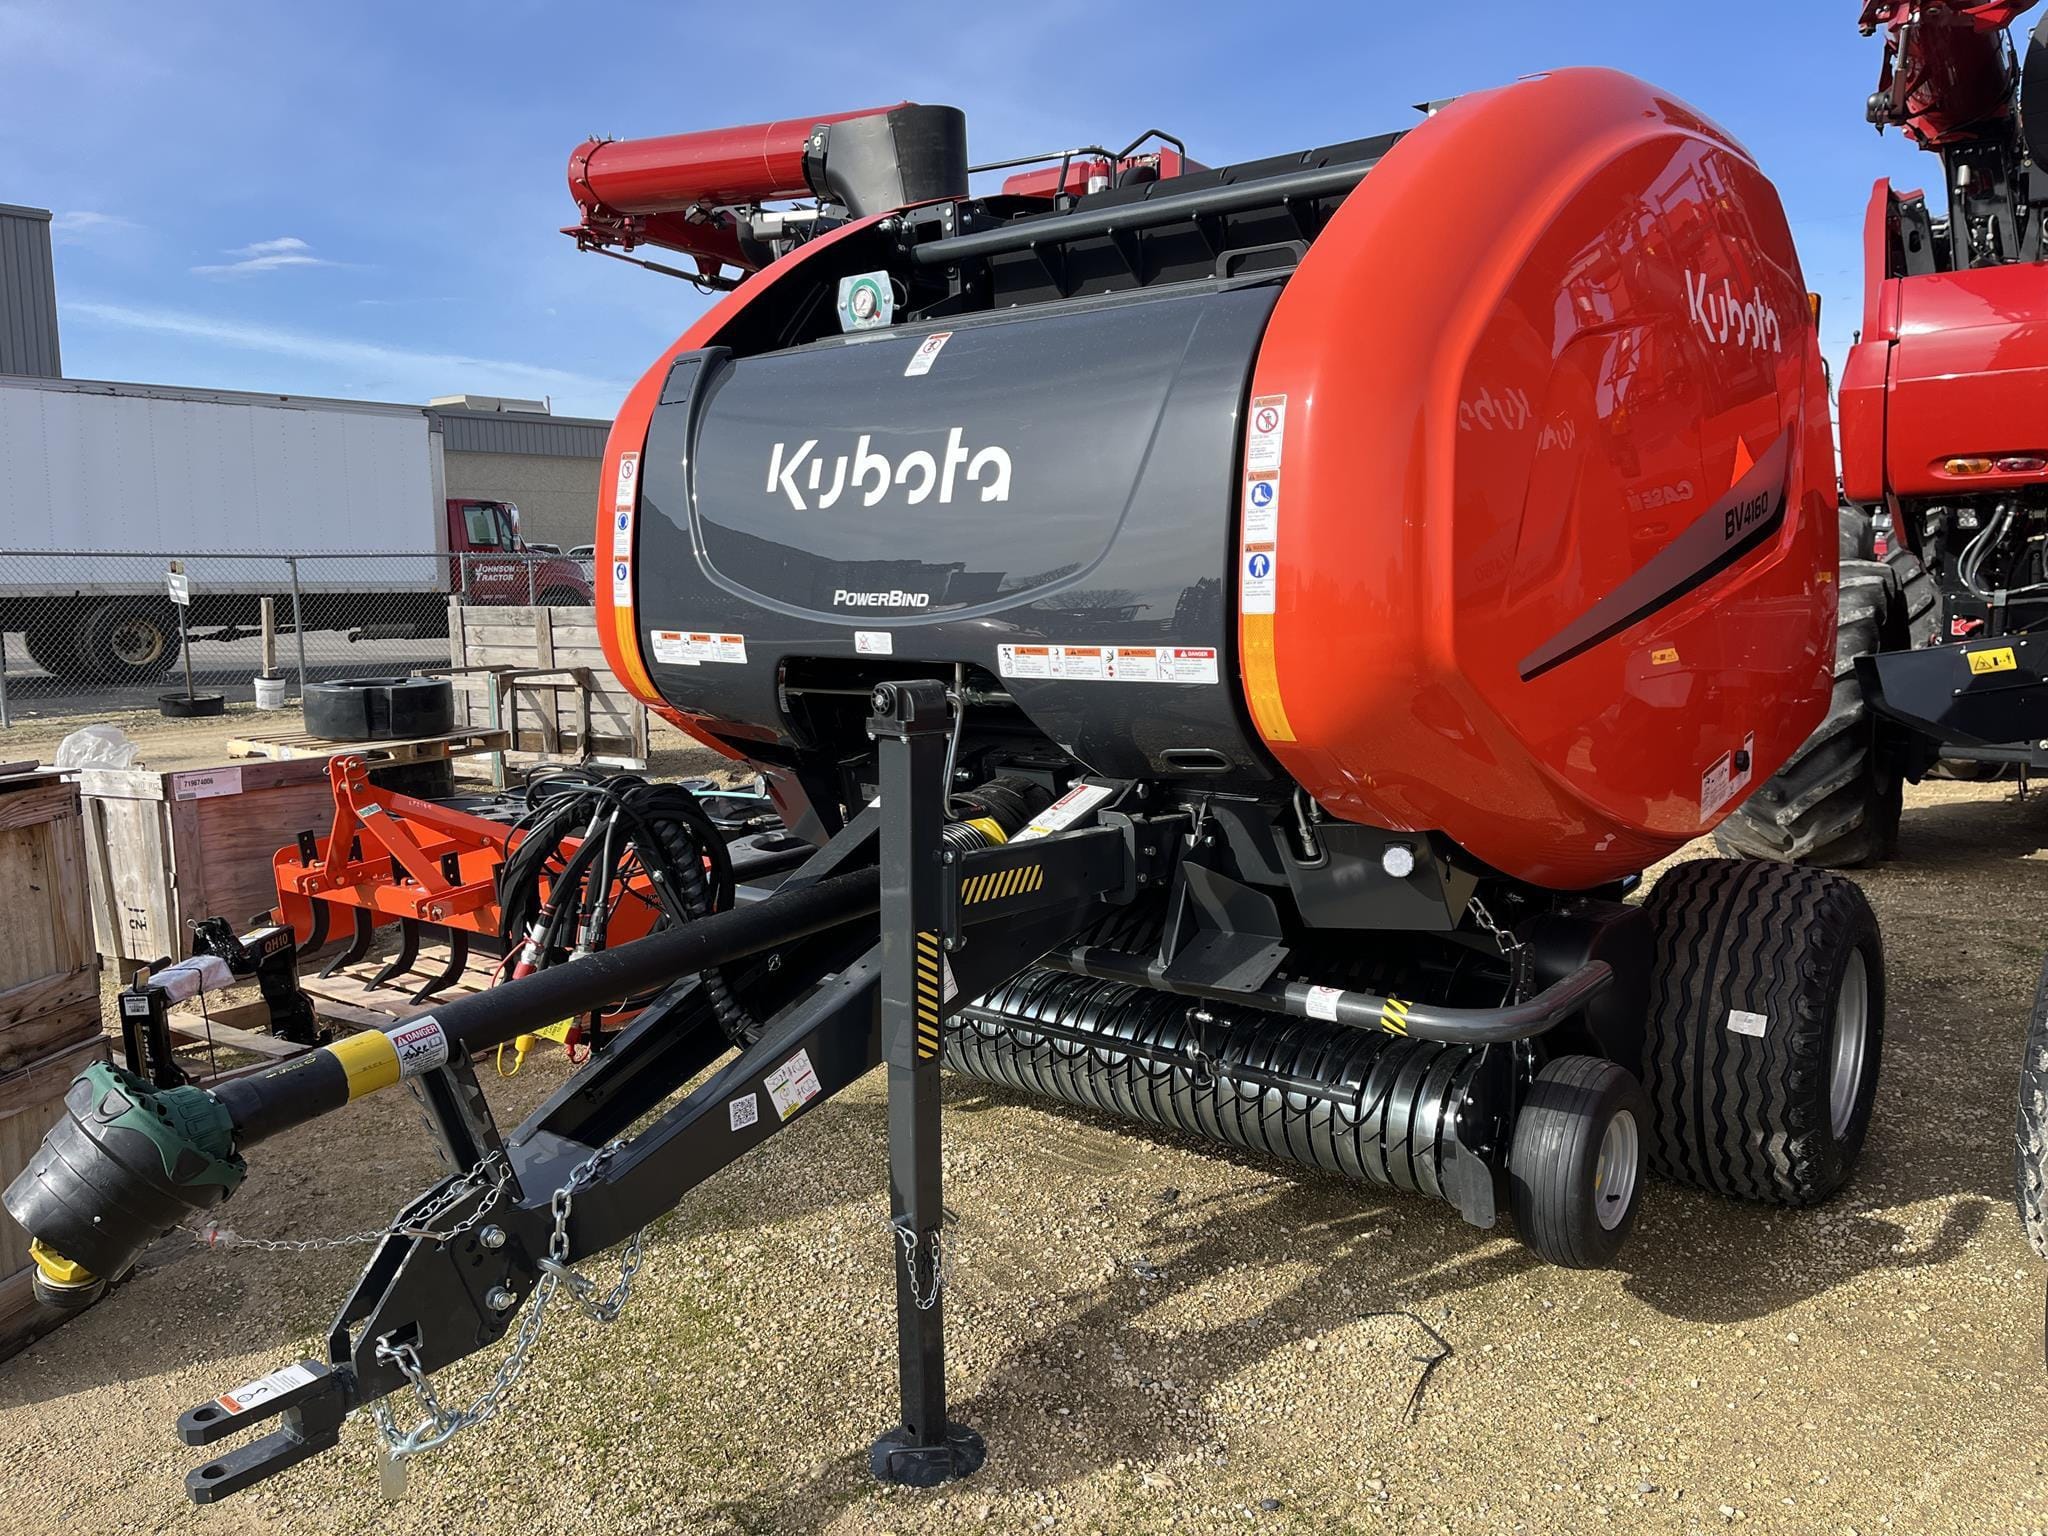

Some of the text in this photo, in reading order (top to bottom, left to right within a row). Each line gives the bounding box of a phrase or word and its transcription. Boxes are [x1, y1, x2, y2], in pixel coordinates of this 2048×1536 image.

[1684, 269, 1781, 353] Kubota
[766, 427, 1012, 511] Kubota
[1725, 491, 1768, 540] BV4160
[475, 564, 515, 573] JOHNSON
[475, 573, 514, 582] TRACTOR
[264, 933, 289, 953] QH10
[406, 1024, 438, 1042] DANGER
